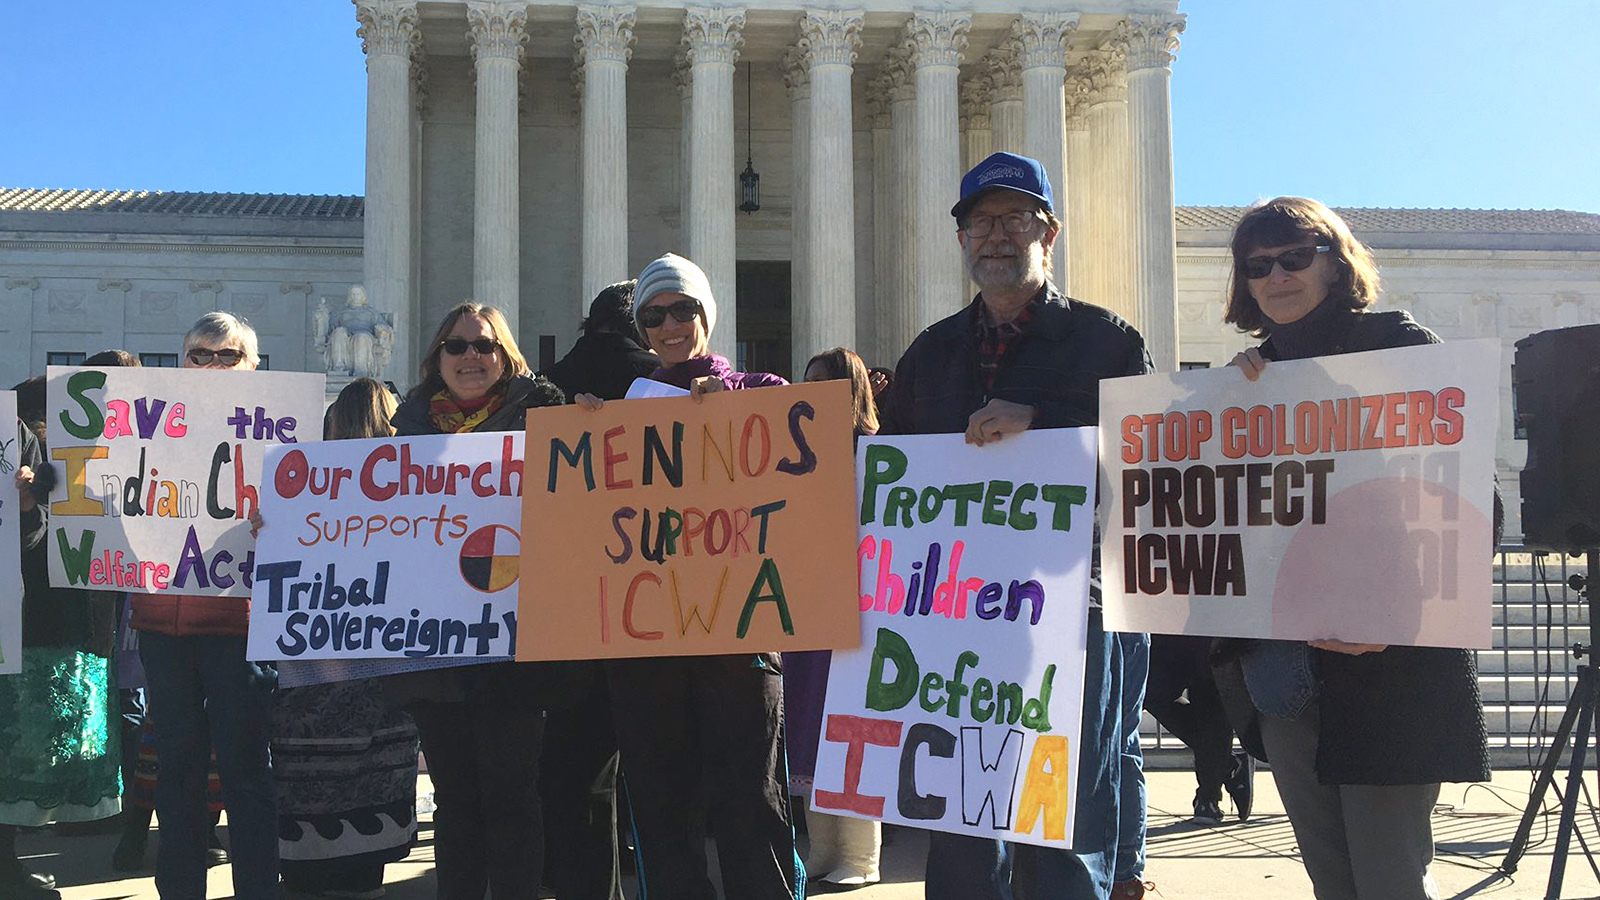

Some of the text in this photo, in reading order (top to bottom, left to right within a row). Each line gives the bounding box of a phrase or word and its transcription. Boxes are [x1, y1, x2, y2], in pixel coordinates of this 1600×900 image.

[60, 371, 297, 443] Save the
[1121, 387, 1465, 464] STOP COLONIZERS
[52, 441, 261, 520] Indian Ch
[274, 435, 524, 501] Our Church
[547, 401, 817, 493] MENNOS
[1122, 459, 1335, 528] PROTECT
[56, 525, 254, 590] Welfare Act
[605, 500, 786, 565] SUPPORT
[1124, 533, 1246, 596] ICWA
[256, 561, 390, 613] Tribal
[600, 558, 794, 644] ICWA
[858, 535, 1045, 625] Children
[865, 628, 1056, 732] Defend
[815, 714, 1068, 840] ICWA
